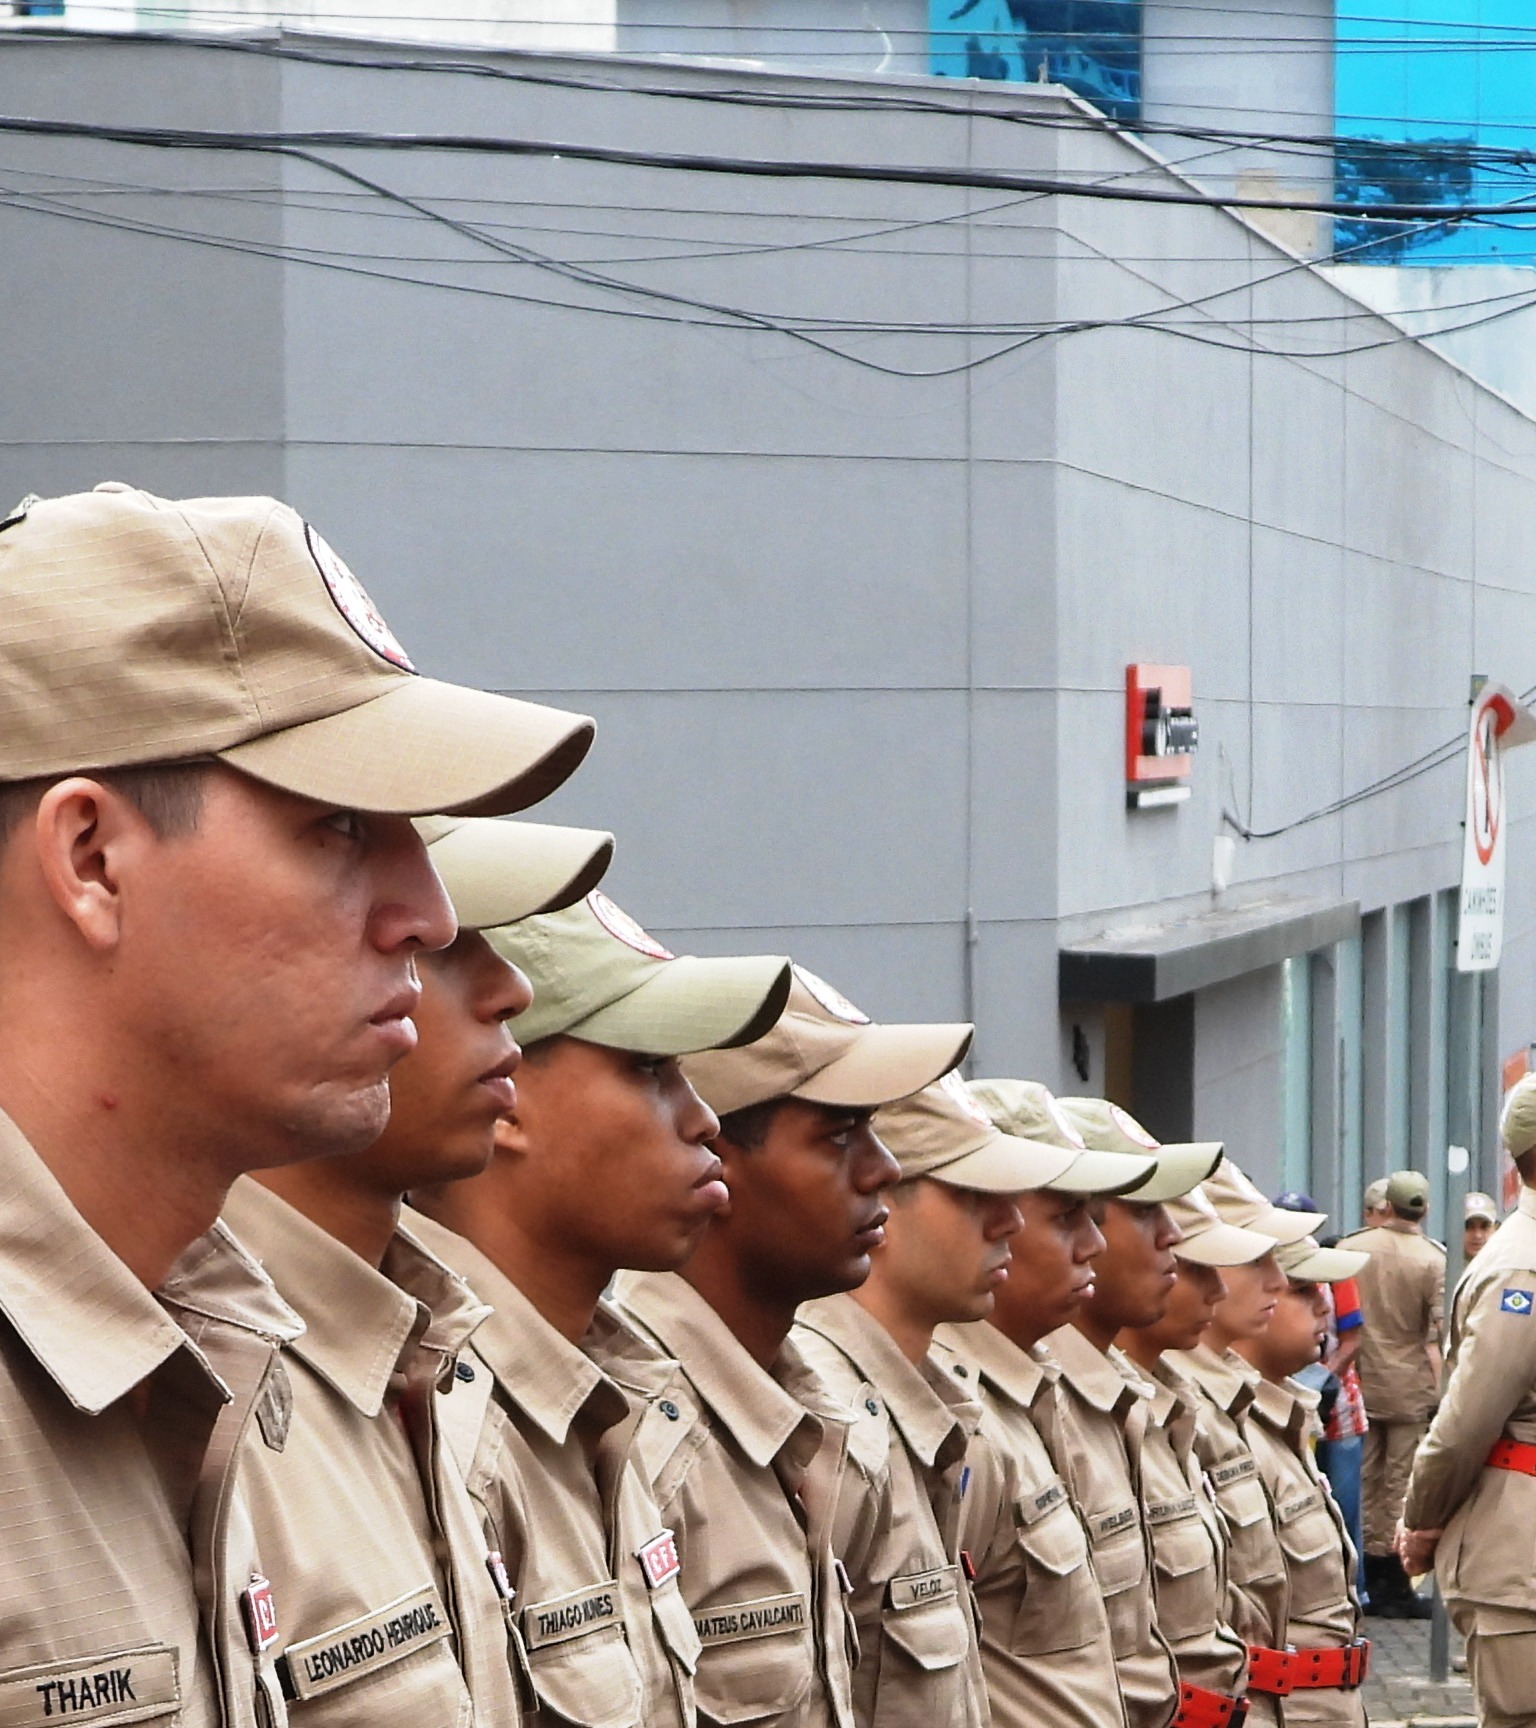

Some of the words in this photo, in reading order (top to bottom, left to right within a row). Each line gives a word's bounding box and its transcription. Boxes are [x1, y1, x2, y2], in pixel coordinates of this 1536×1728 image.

[537, 1604, 583, 1636] THIAGO
[582, 1593, 614, 1622] NUNES
[740, 1604, 804, 1631] CAVALCANTI
[303, 1628, 385, 1682] LEONARDO
[383, 1603, 441, 1649] HENRIQUE
[36, 1668, 137, 1716] THARIK
